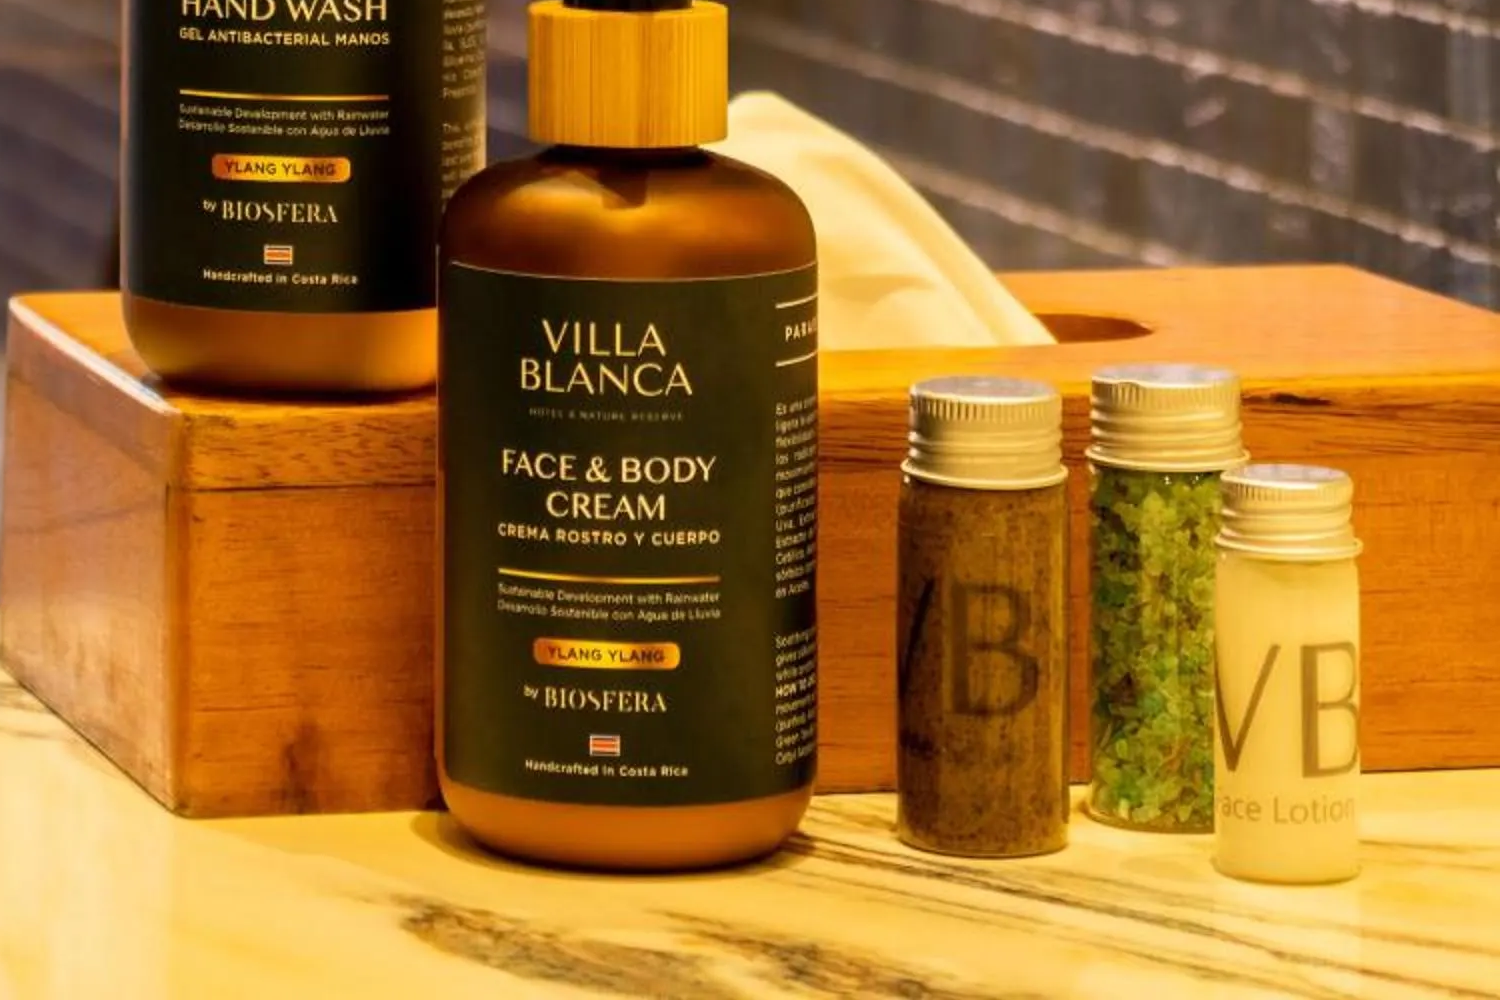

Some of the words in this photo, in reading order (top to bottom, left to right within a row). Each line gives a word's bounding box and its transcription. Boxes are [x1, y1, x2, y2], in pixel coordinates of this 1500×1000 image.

[179, 27, 204, 43] GEL
[207, 29, 330, 46] ANTIBACTERIAL
[335, 32, 390, 46] MANOS
[235, 107, 308, 122] Development
[310, 109, 335, 120] with
[337, 109, 390, 120] Rainwater
[228, 123, 283, 136] Sostenible
[286, 126, 307, 136] con
[310, 125, 339, 139] Agua
[341, 125, 356, 136] de
[224, 160, 277, 175] YLANG
[281, 163, 336, 177] YLANG
[203, 198, 217, 213] by
[221, 199, 339, 224] BIOSFERA
[203, 268, 273, 285] Handcrafted
[276, 272, 288, 285] in
[291, 273, 328, 286] Costa
[331, 273, 359, 286] Rica
[541, 319, 667, 357] VILLA
[520, 358, 693, 397] BLANCA
[528, 407, 563, 419] HOTEL
[579, 410, 625, 421] NATURE
[501, 448, 577, 481] FACE
[585, 456, 611, 483] &
[620, 456, 717, 484] BODY
[546, 491, 666, 521] CREAM
[497, 523, 549, 541] CREMA
[556, 529, 627, 546] ROSTRO
[634, 532, 645, 546] Y
[651, 530, 720, 546] CUERPO
[557, 590, 634, 605] Development
[637, 592, 663, 604] with
[665, 592, 720, 604] Rainwater
[550, 605, 608, 620] Sostenible
[612, 609, 635, 620] con
[638, 608, 668, 623] Agua
[671, 609, 686, 621] de
[688, 608, 720, 620] Lluvia
[547, 646, 602, 662] YLANG
[608, 649, 666, 664] YLANG
[523, 684, 538, 700] by
[545, 686, 667, 713] BIOSFERA
[1214, 642, 1359, 777] VB
[525, 759, 599, 777] Handcrafted
[602, 763, 615, 777] in
[619, 764, 656, 777] Costa
[660, 764, 689, 777] Rica
[1216, 796, 1262, 821] ace
[1273, 795, 1355, 824] Lotion
